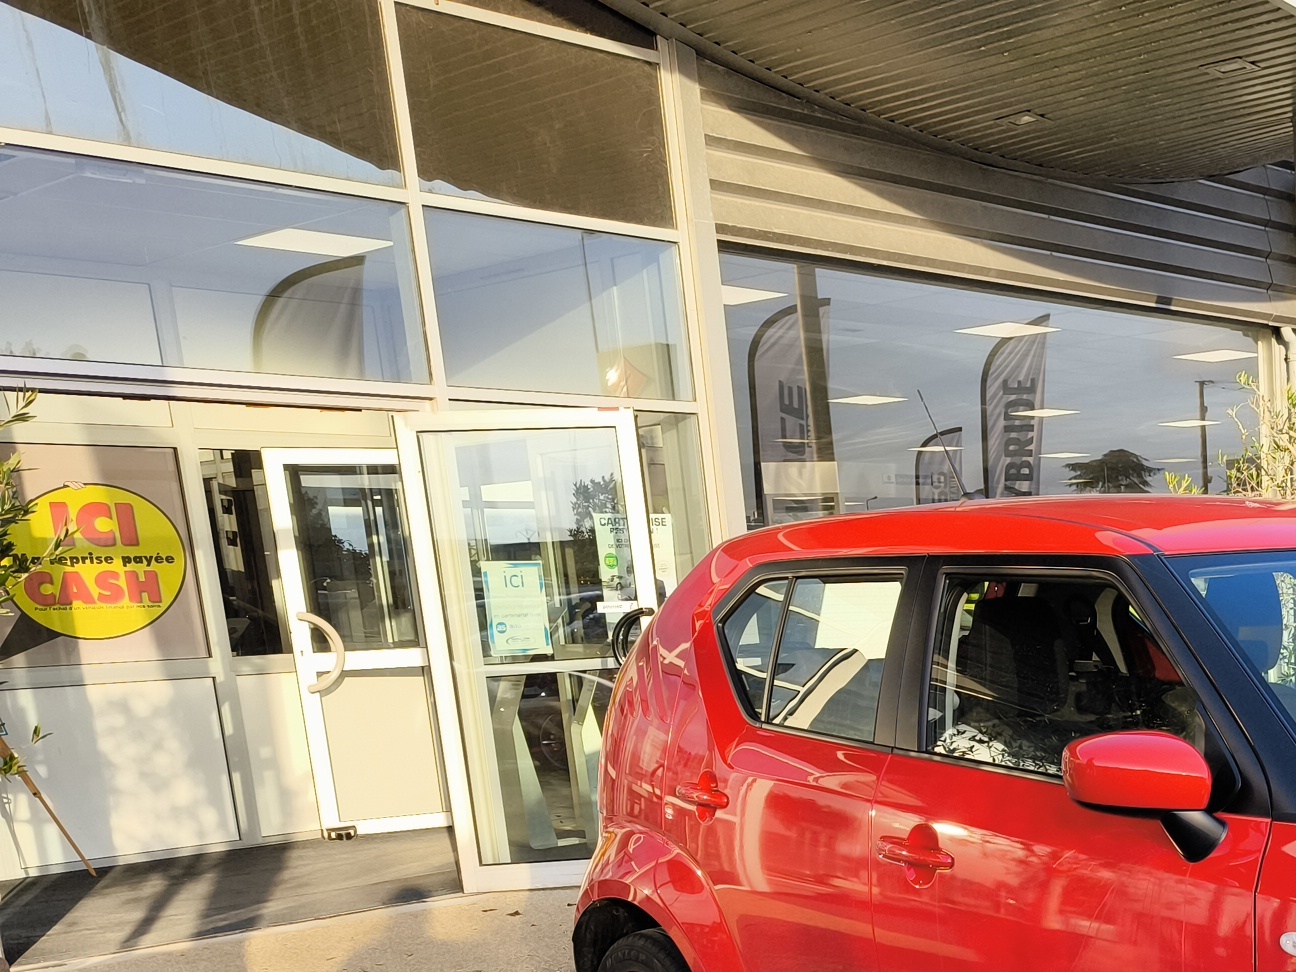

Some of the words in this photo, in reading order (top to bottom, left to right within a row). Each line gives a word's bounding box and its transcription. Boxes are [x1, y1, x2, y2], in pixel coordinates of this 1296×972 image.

[1002, 377, 1036, 496] YBRIDE
[49, 501, 140, 548] ICI
[599, 517, 627, 527] CART
[122, 552, 175, 567] payée
[24, 570, 163, 606] CASH
[503, 571, 525, 588] ici
